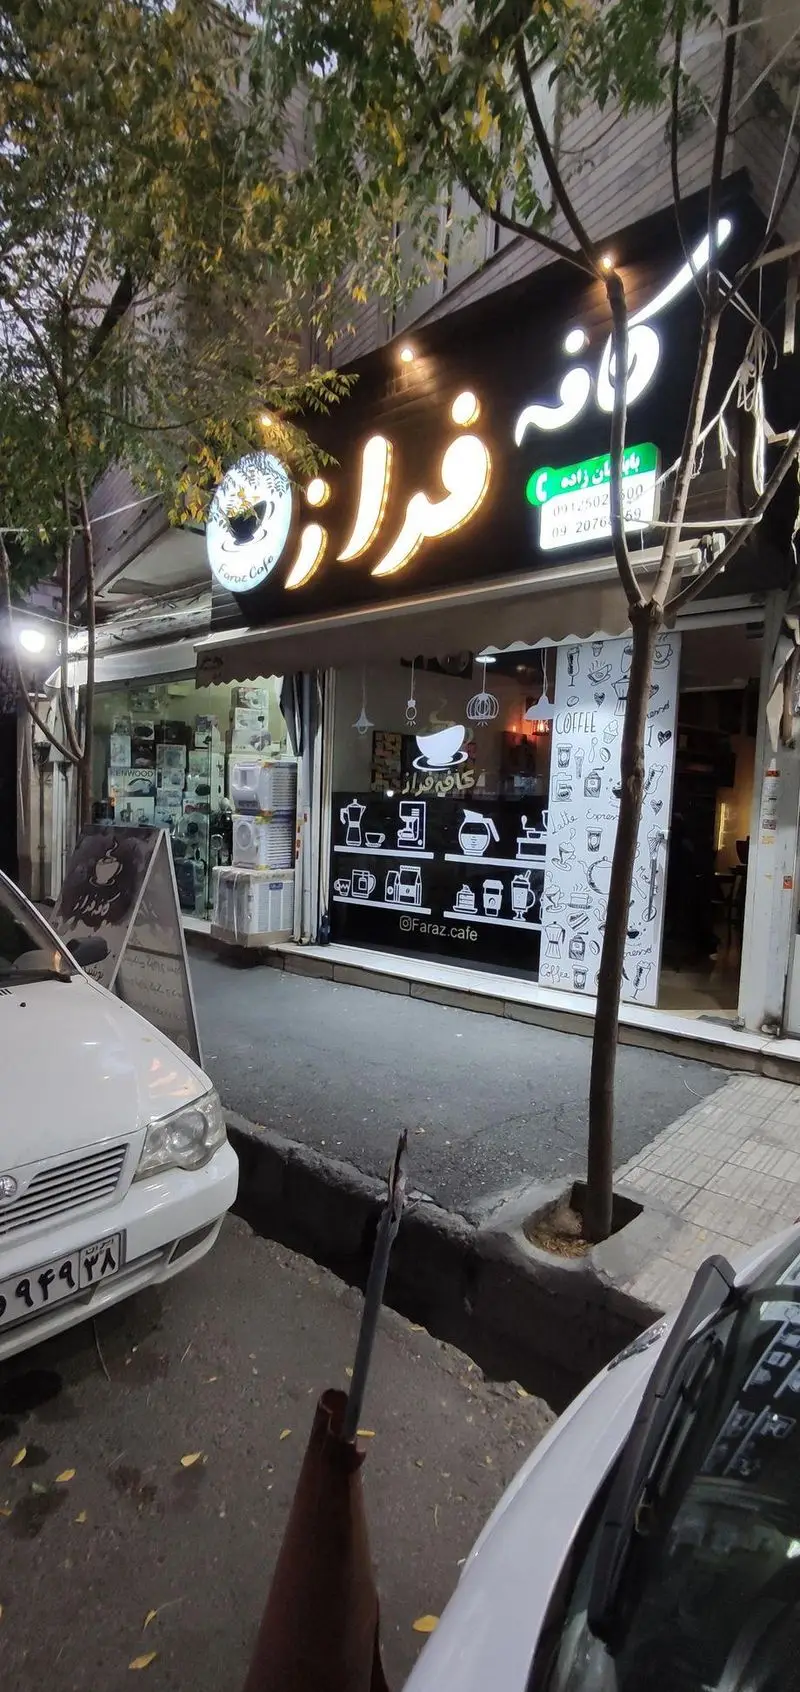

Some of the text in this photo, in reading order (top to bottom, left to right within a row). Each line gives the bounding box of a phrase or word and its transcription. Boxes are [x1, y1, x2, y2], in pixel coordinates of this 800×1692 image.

[284, 218, 732, 591] کافه فراز
[561, 468, 589, 488] زاده
[556, 710, 597, 734] COFFEE
[402, 769, 475, 797] کافه فراز
[552, 810, 580, 834] Latte
[73, 892, 121, 916] کافه فراز
[412, 918, 478, 941] Faraz.cafe
[540, 963, 570, 984] Coffee
[84, 1248, 116, 1281] ۳۸
